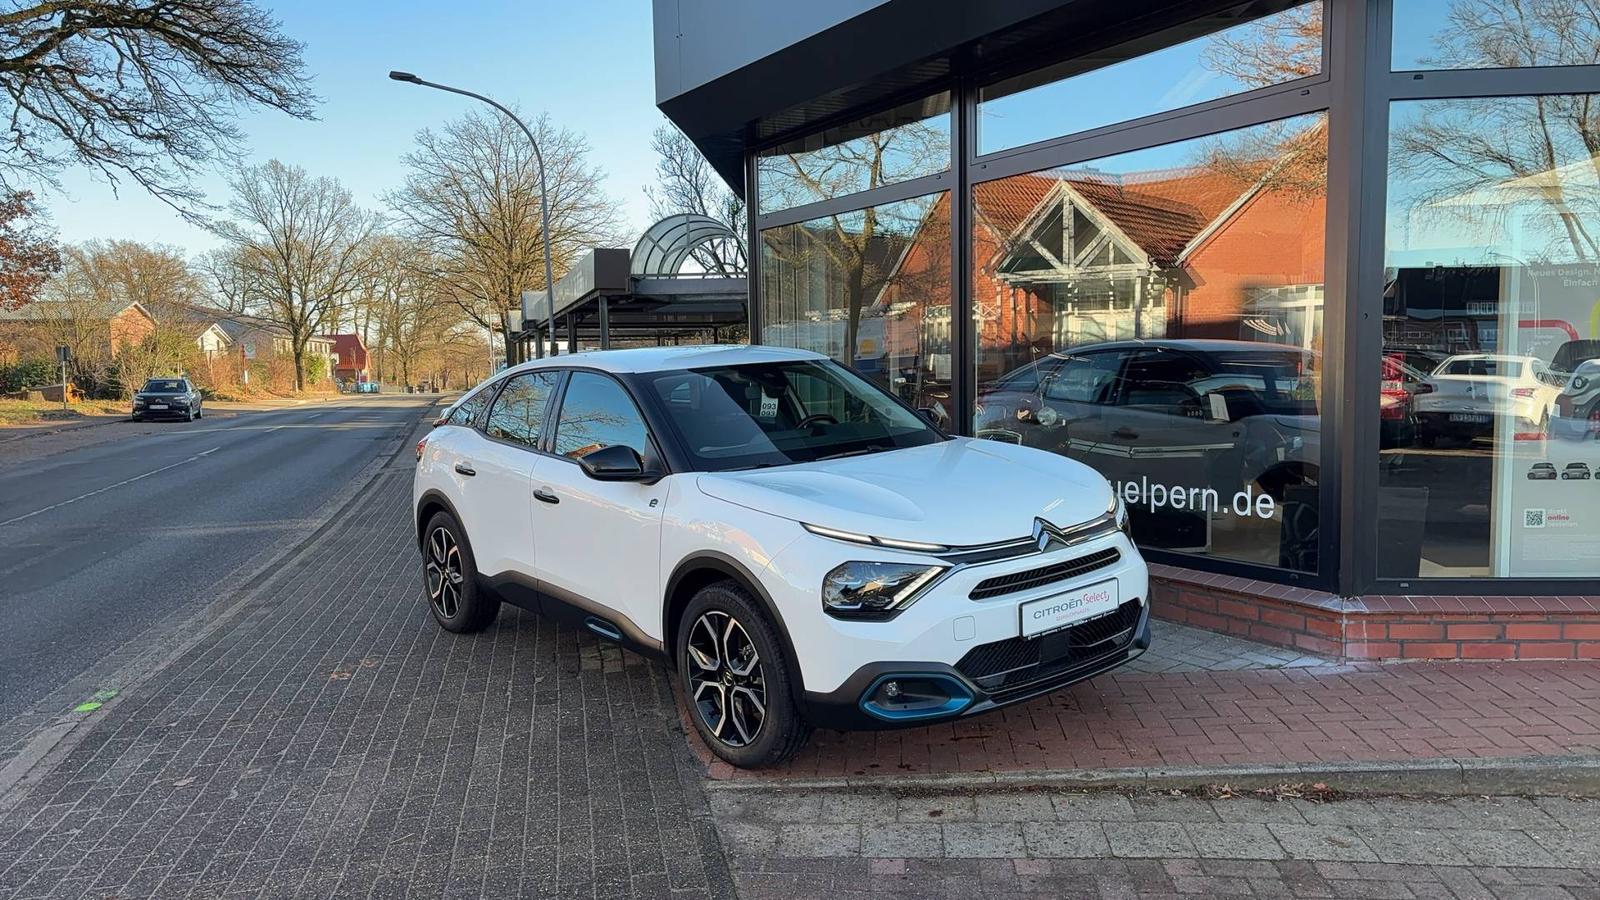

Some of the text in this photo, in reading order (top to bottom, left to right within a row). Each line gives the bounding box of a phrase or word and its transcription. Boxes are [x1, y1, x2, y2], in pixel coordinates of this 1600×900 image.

[1563, 279, 1598, 287] Einfach
[762, 402, 776, 410] 093
[1547, 513, 1570, 521] online
